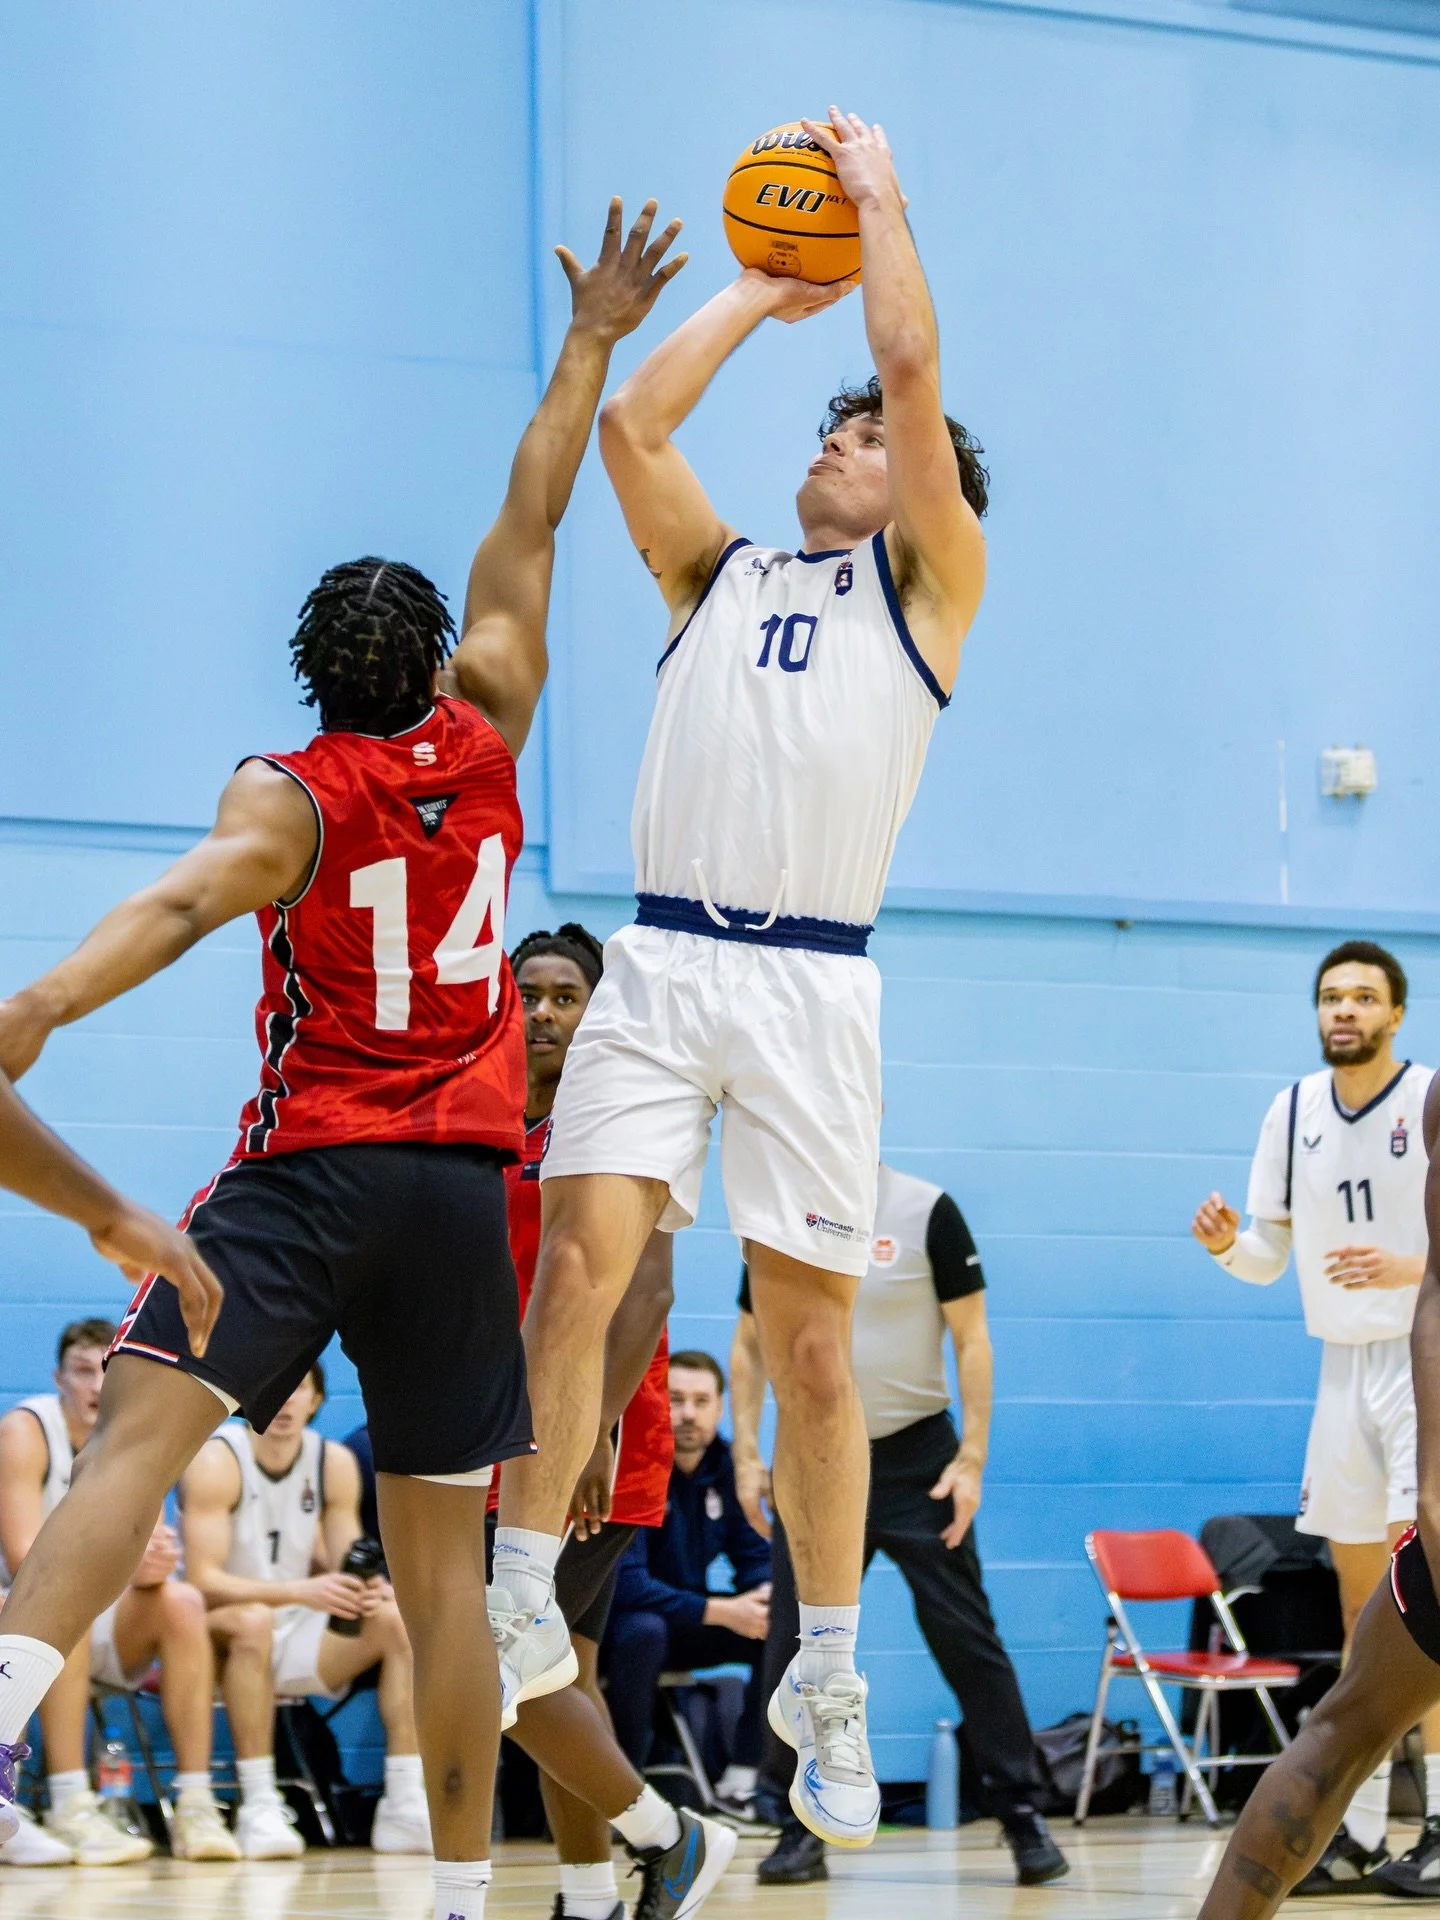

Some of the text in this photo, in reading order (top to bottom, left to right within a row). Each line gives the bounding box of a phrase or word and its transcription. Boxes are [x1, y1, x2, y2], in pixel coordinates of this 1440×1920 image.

[755, 183, 826, 213] EVO
[756, 612, 819, 673] 10
[350, 832, 507, 1031] 14
[1336, 1178, 1374, 1223] 11
[266, 1530, 280, 1564] 1
